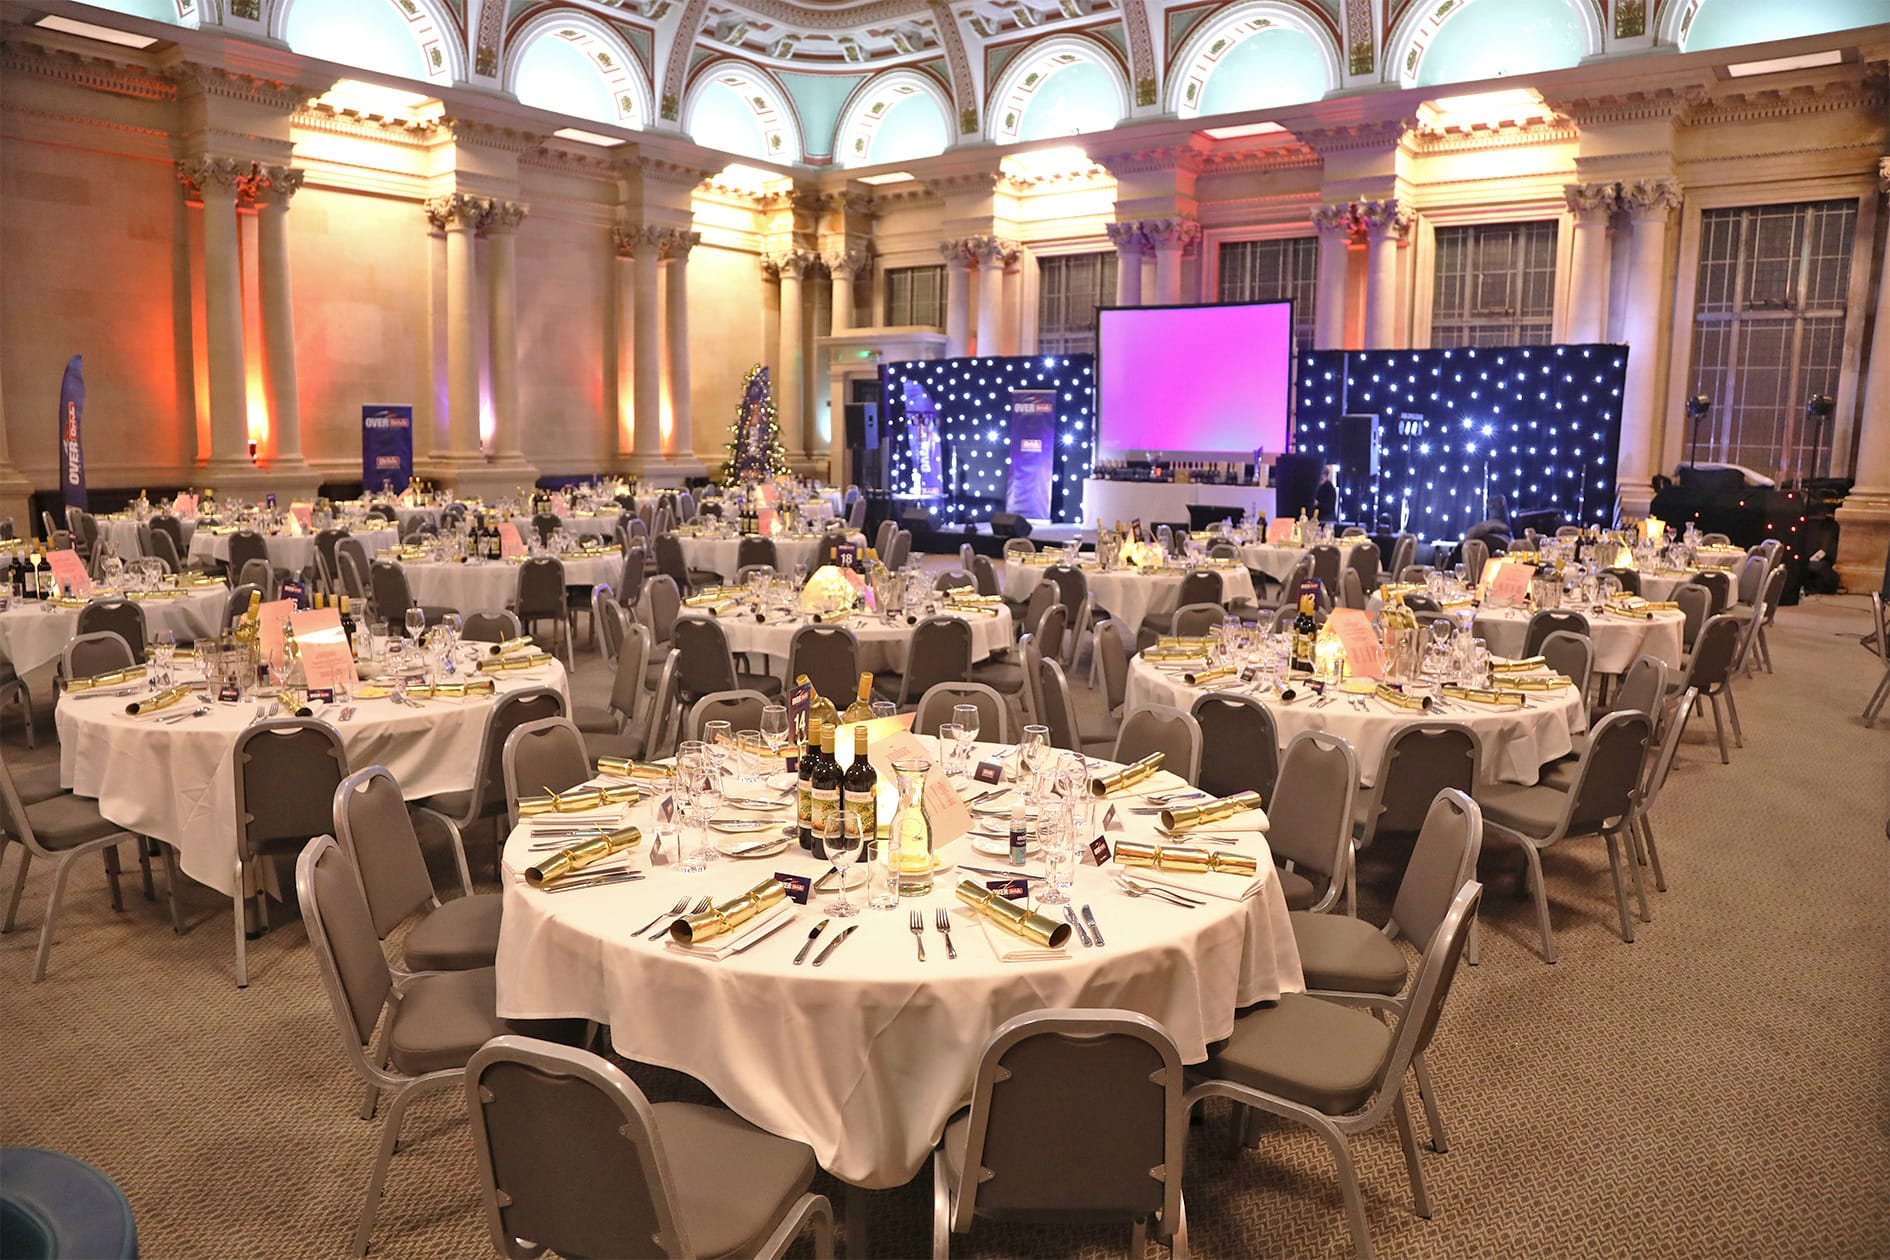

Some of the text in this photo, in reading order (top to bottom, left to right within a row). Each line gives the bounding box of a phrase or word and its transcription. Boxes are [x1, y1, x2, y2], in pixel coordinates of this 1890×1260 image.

[1014, 403, 1035, 412] OVER
[366, 417, 389, 428] OVER
[69, 441, 80, 485] OVER
[841, 553, 853, 565] 18
[794, 710, 806, 731] 14
